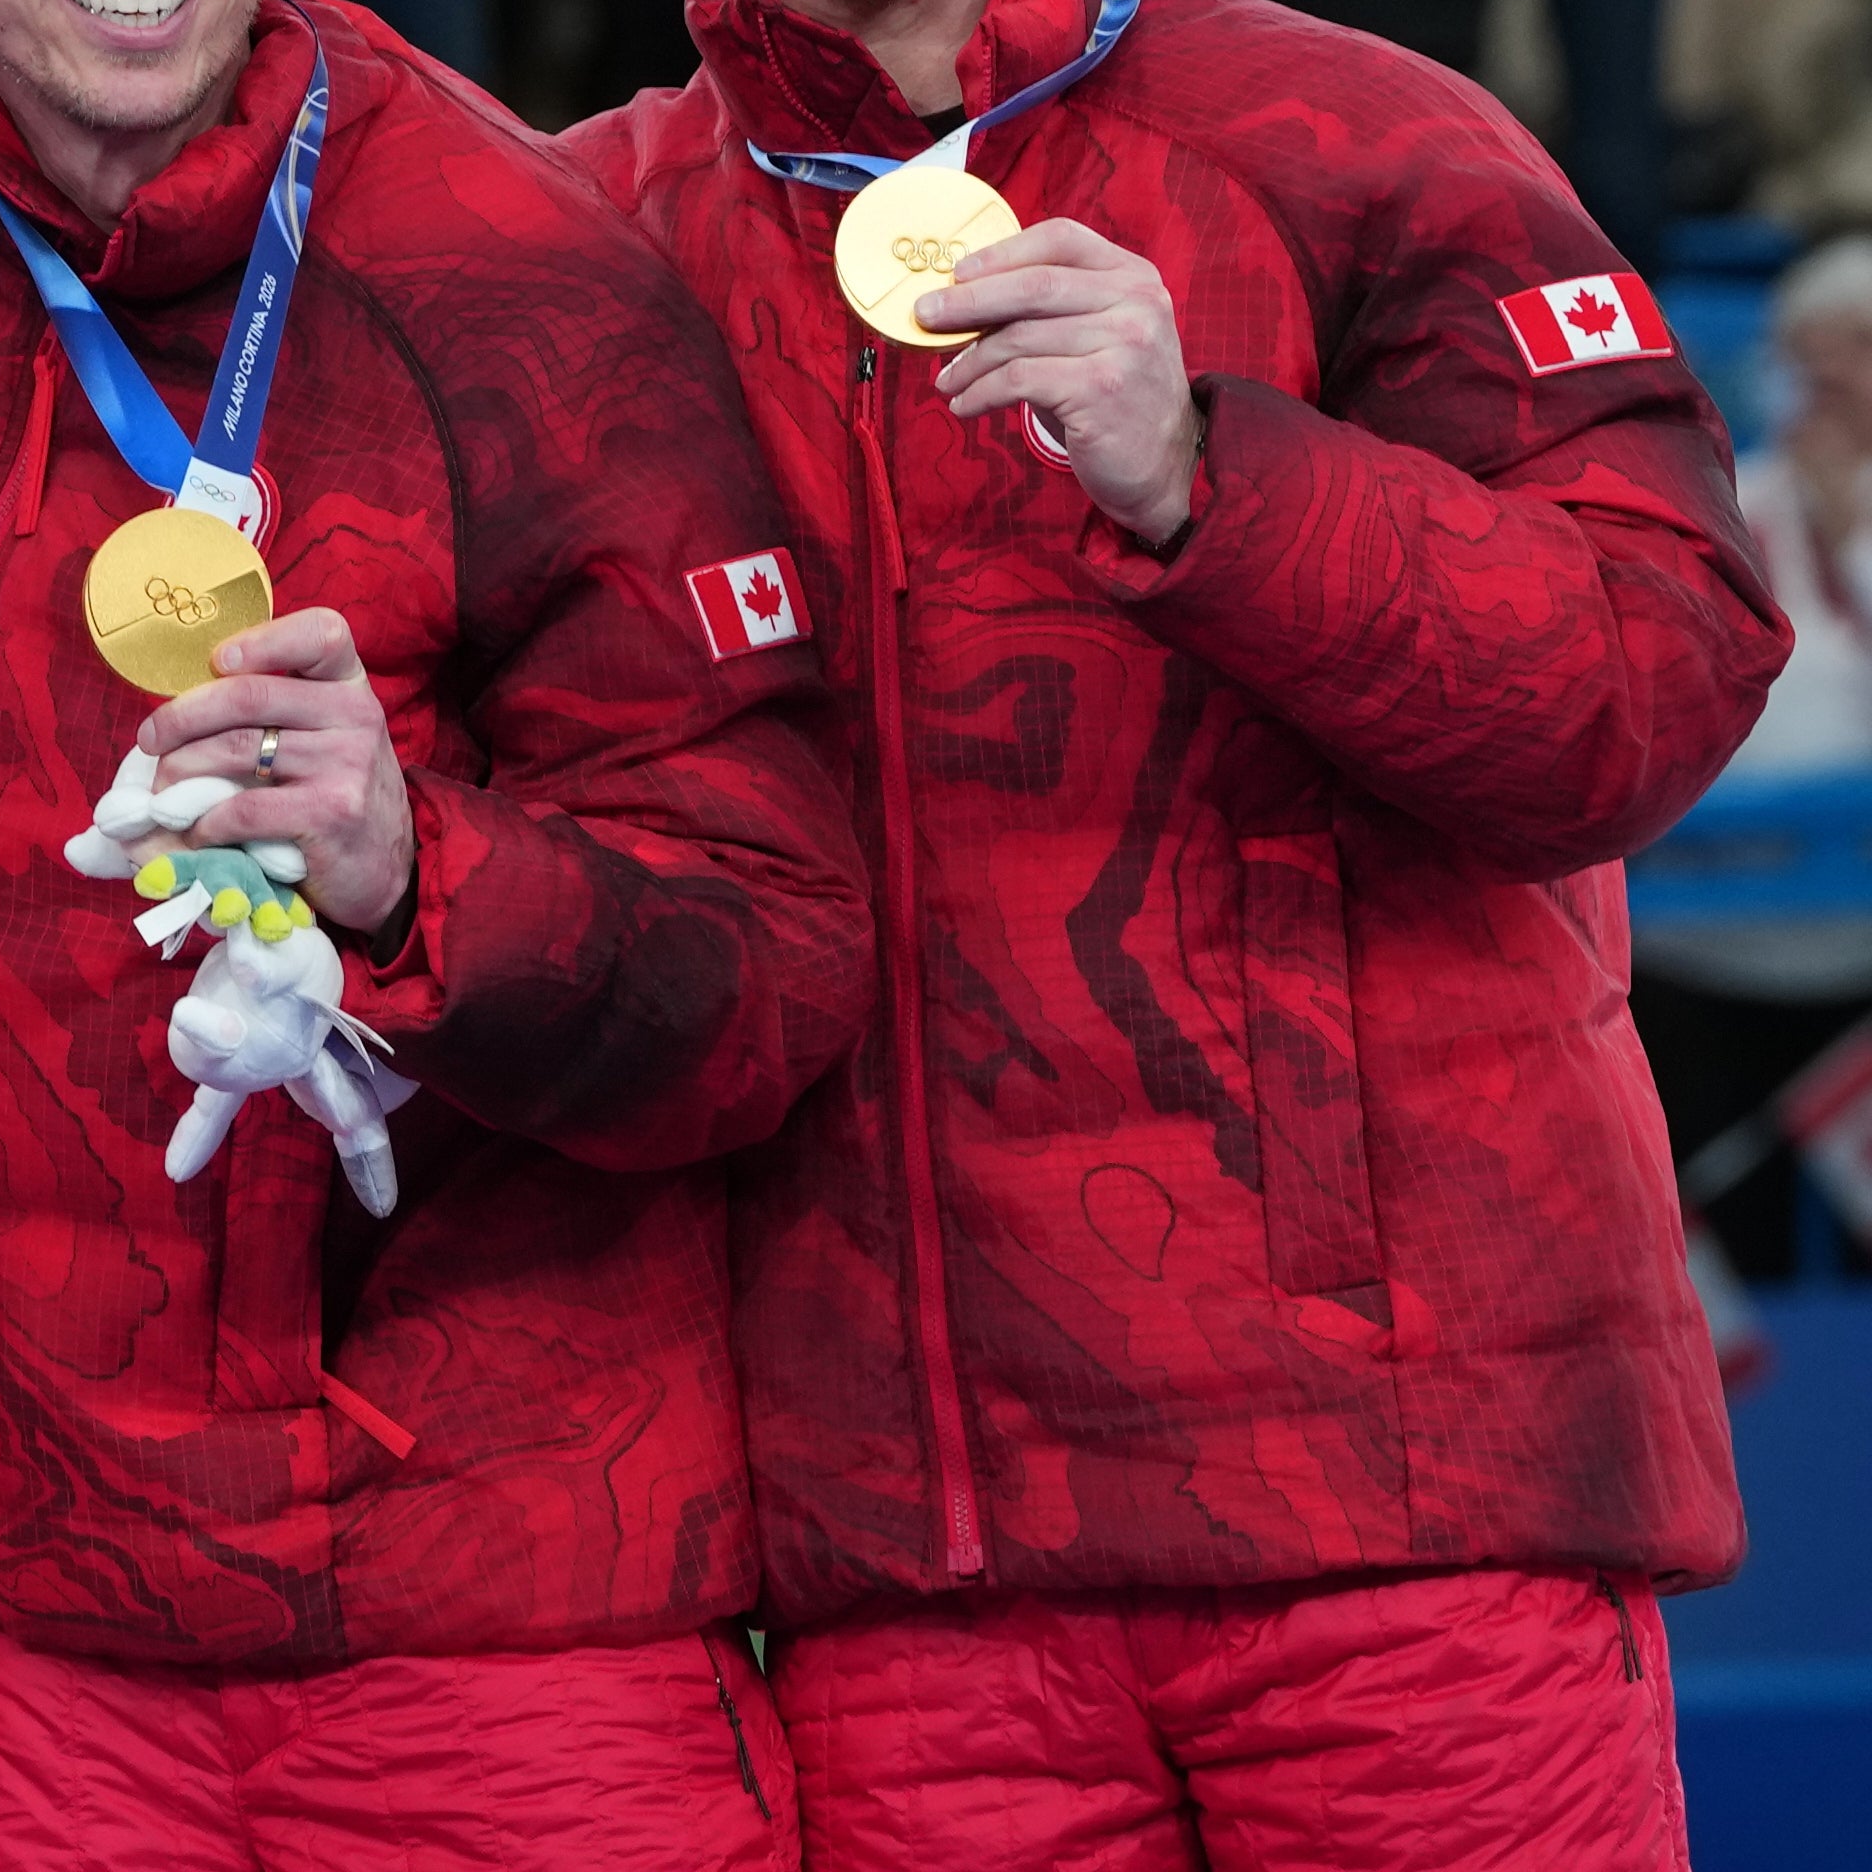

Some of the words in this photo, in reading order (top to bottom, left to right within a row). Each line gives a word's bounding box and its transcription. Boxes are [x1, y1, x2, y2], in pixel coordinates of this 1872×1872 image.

[222, 373, 248, 441] MILANO
[239, 311, 269, 377] CORTINA
[258, 271, 277, 309] 2026
